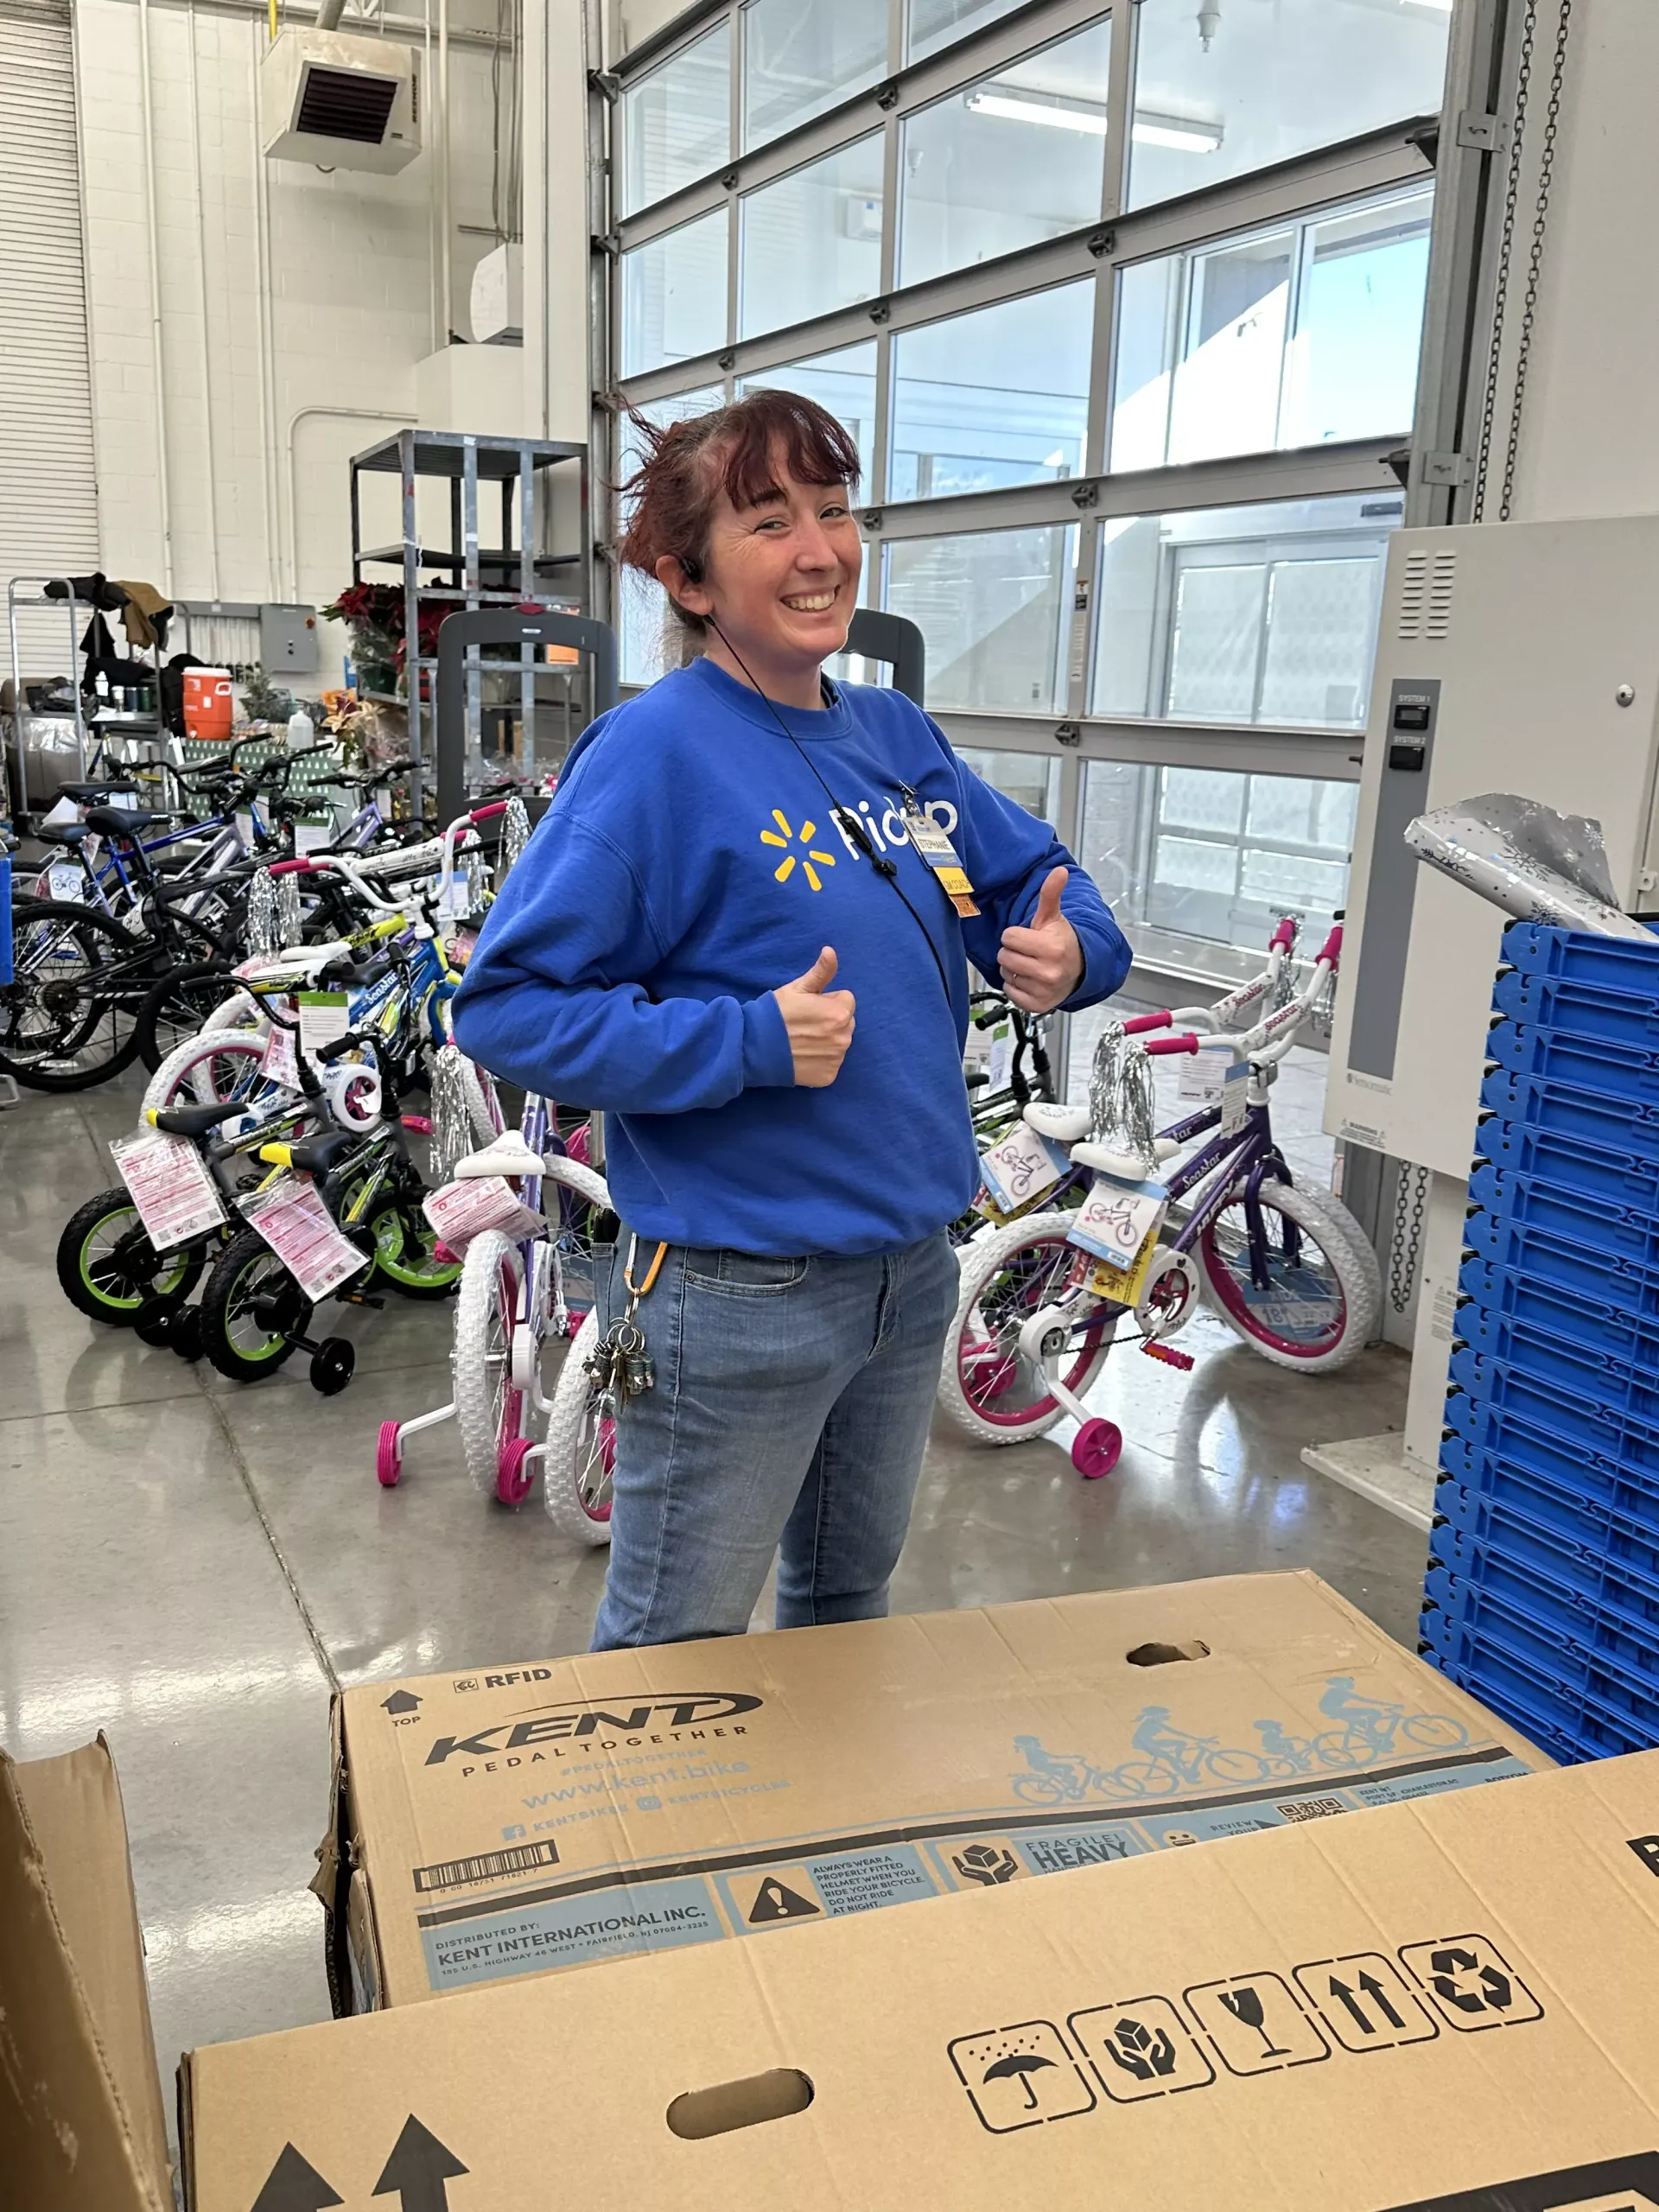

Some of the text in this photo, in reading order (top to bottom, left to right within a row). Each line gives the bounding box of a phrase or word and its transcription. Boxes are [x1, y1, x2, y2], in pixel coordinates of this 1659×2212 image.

[1182, 1152, 1221, 1190] Seastar
[485, 1669, 552, 1688] RFID
[391, 1716, 421, 1727] TOP
[424, 1693, 763, 1766] KENT
[462, 1726, 748, 1777] PEDAL TOGETHER
[562, 1749, 708, 1776] #PEDALTOGETHER
[521, 1759, 751, 1808] www.kent.bike
[1211, 1820, 1252, 1832] REVIEW
[1026, 1834, 1122, 1851] FRAGILE!
[813, 1861, 853, 1873] ALWAYS
[853, 1857, 882, 1867] WEAR
[1032, 1841, 1128, 1869] HEAVY
[816, 1862, 904, 1882] PROPERLY FITTED
[821, 1878, 861, 1890] HELMET
[861, 1873, 893, 1883] WHEN
[823, 1888, 849, 1897] RIDE
[849, 1884, 879, 1894] YOUR
[869, 1890, 894, 1899] RIDE
[833, 1906, 845, 1915] AT
[435, 1923, 540, 1949] DISTRIBUTED BY:
[439, 1906, 706, 1966] KENT INTERNATIONAL INC.
[485, 1952, 531, 1967] HIGHWAY
[550, 1944, 575, 1953] WEST
[654, 1921, 709, 1935] 07004-3225
